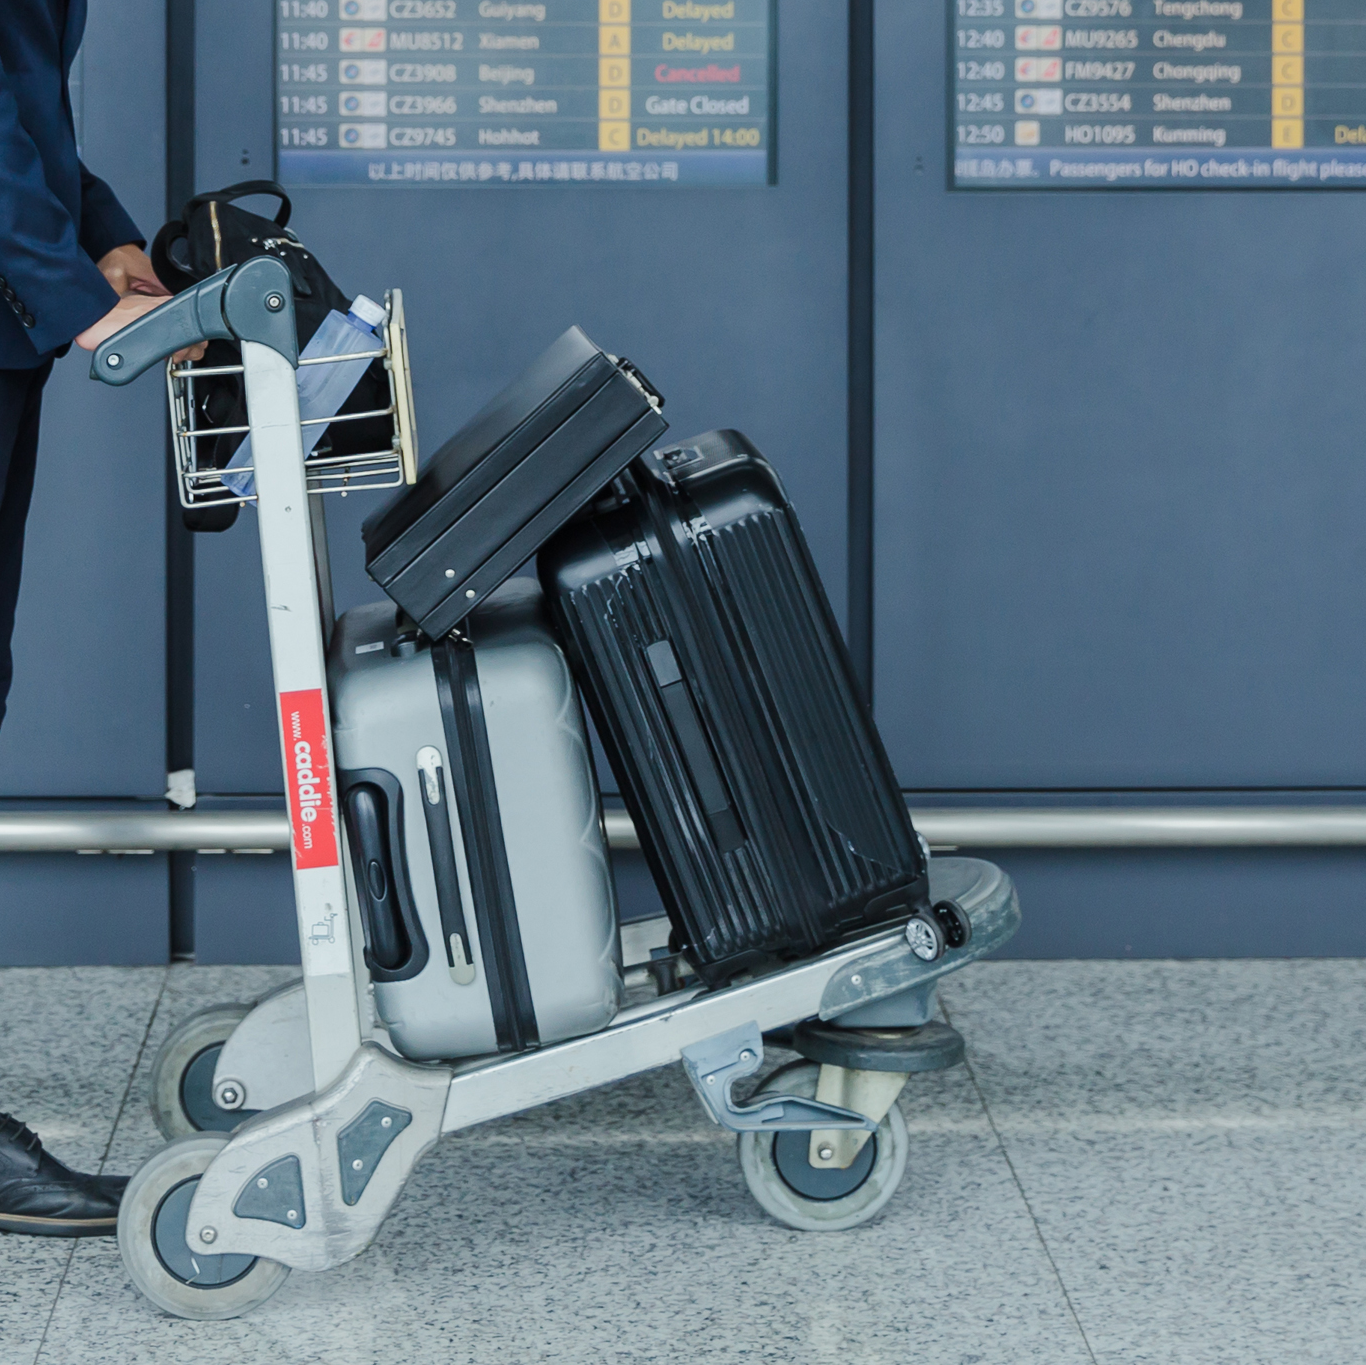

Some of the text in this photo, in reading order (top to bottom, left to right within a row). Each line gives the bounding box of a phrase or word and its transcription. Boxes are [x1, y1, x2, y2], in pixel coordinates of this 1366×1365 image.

[958, 61, 1005, 80] 12:40
[281, 96, 327, 113] 11:45
[646, 96, 687, 114] Gate
[690, 96, 750, 114] Closed
[958, 93, 1004, 112] 12:45
[958, 125, 1004, 143] 12:50
[1049, 159, 1142, 181] Passengers
[1144, 159, 1169, 177] for
[1171, 160, 1199, 177] HO
[1201, 159, 1270, 177] check-in
[1272, 159, 1317, 181] flight
[291, 711, 322, 849] www.caddie.com
